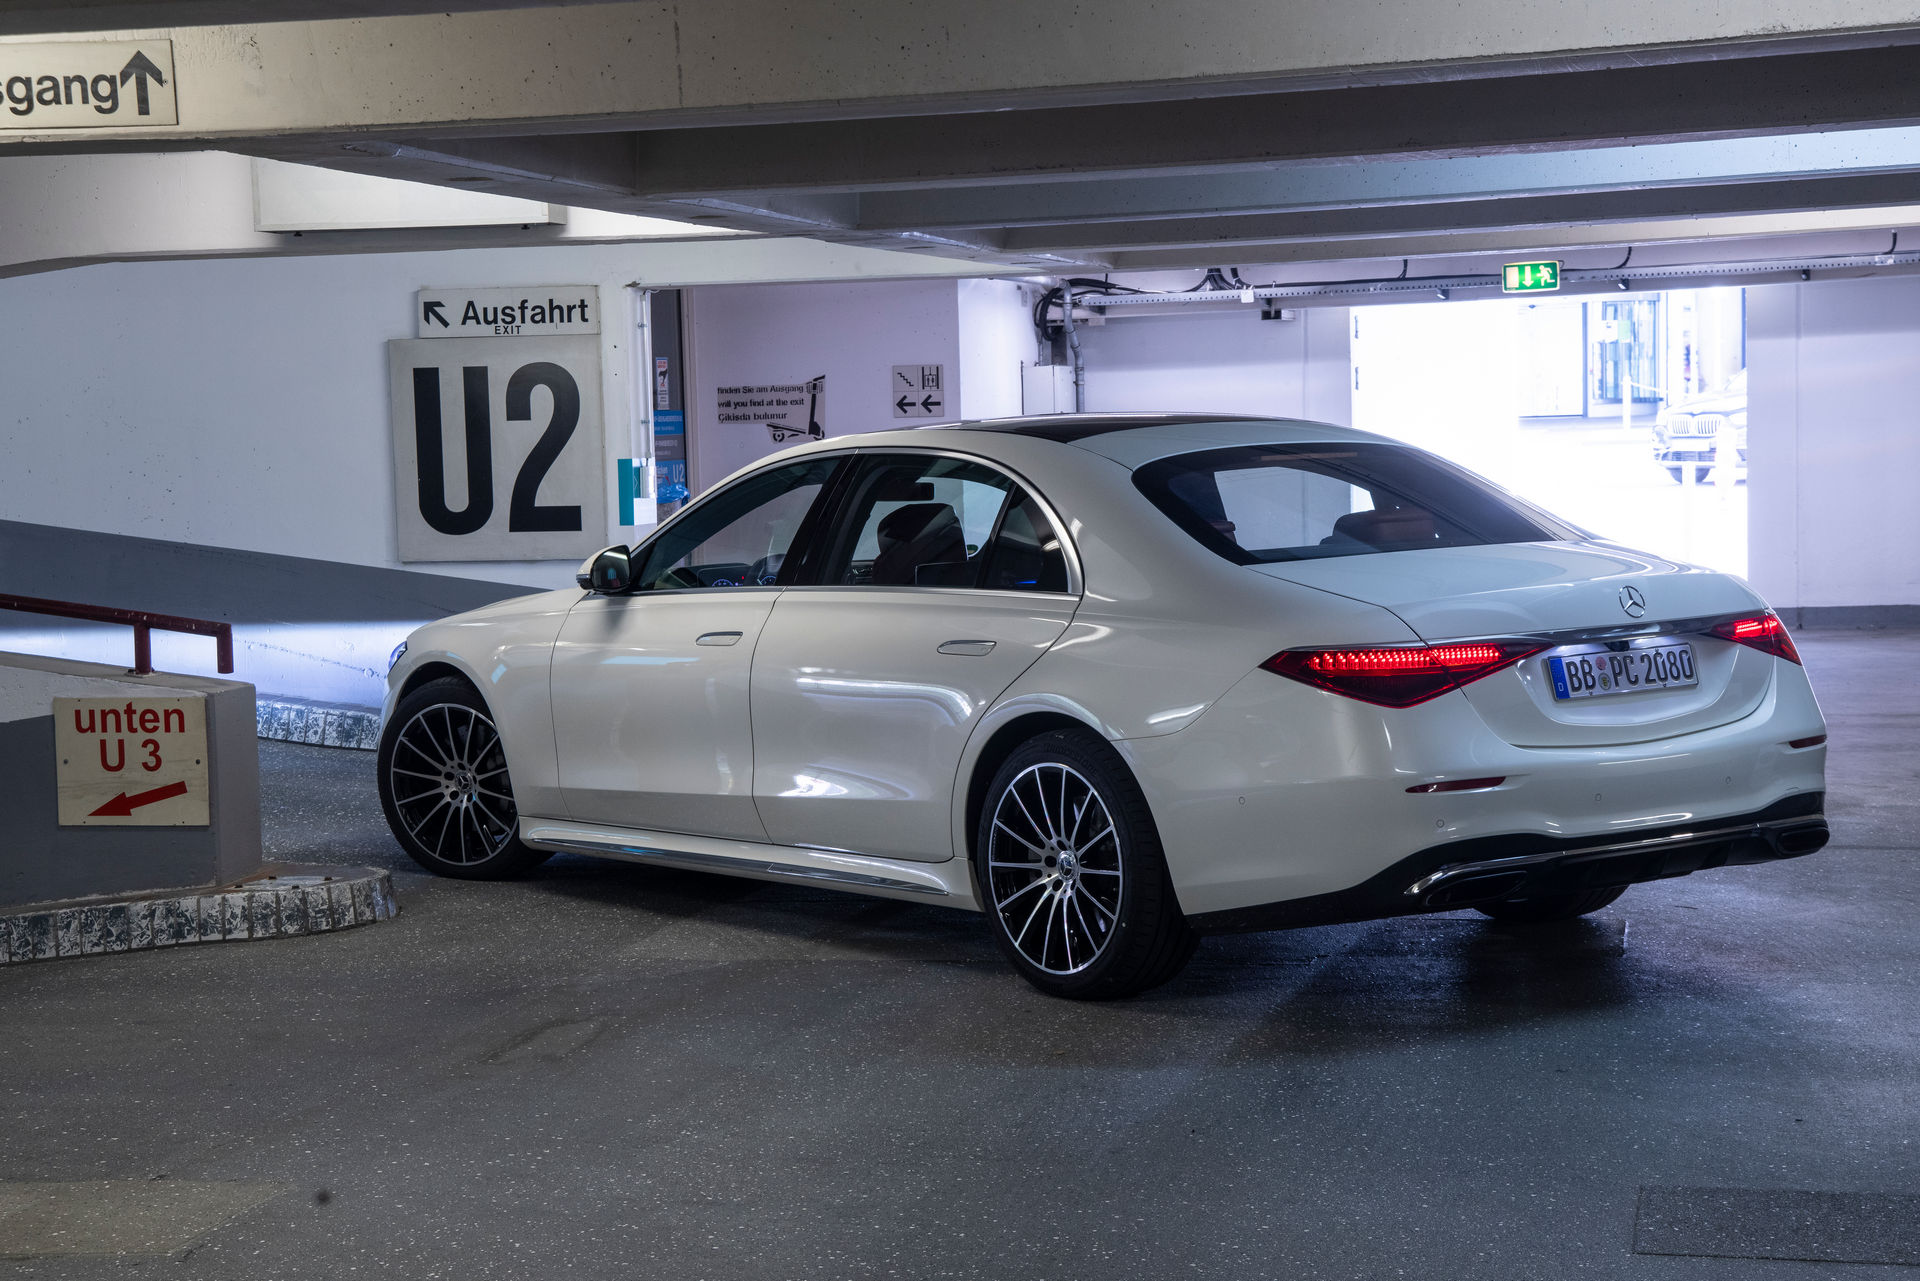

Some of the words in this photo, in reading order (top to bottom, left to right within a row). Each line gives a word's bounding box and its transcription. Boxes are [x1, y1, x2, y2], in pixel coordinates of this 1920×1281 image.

[0, 74, 119, 116] gang
[461, 299, 589, 325] Ausfahrt
[494, 325, 521, 335] EXIT
[717, 386, 741, 395] finden
[742, 386, 754, 394] Sie
[770, 385, 804, 394] Ausgang
[718, 400, 731, 408] will
[734, 401, 748, 409] you
[776, 398, 788, 406] the
[790, 398, 804, 406] exit
[753, 412, 788, 420] bulunur
[413, 361, 582, 535] U2
[672, 463, 685, 483] U2
[1565, 659, 1597, 693] BB
[1608, 654, 1639, 688] PC
[1640, 650, 1694, 684] 2080
[1557, 682, 1564, 692] D
[74, 701, 185, 734] unten
[100, 739, 125, 772] U
[141, 738, 162, 772] 3
